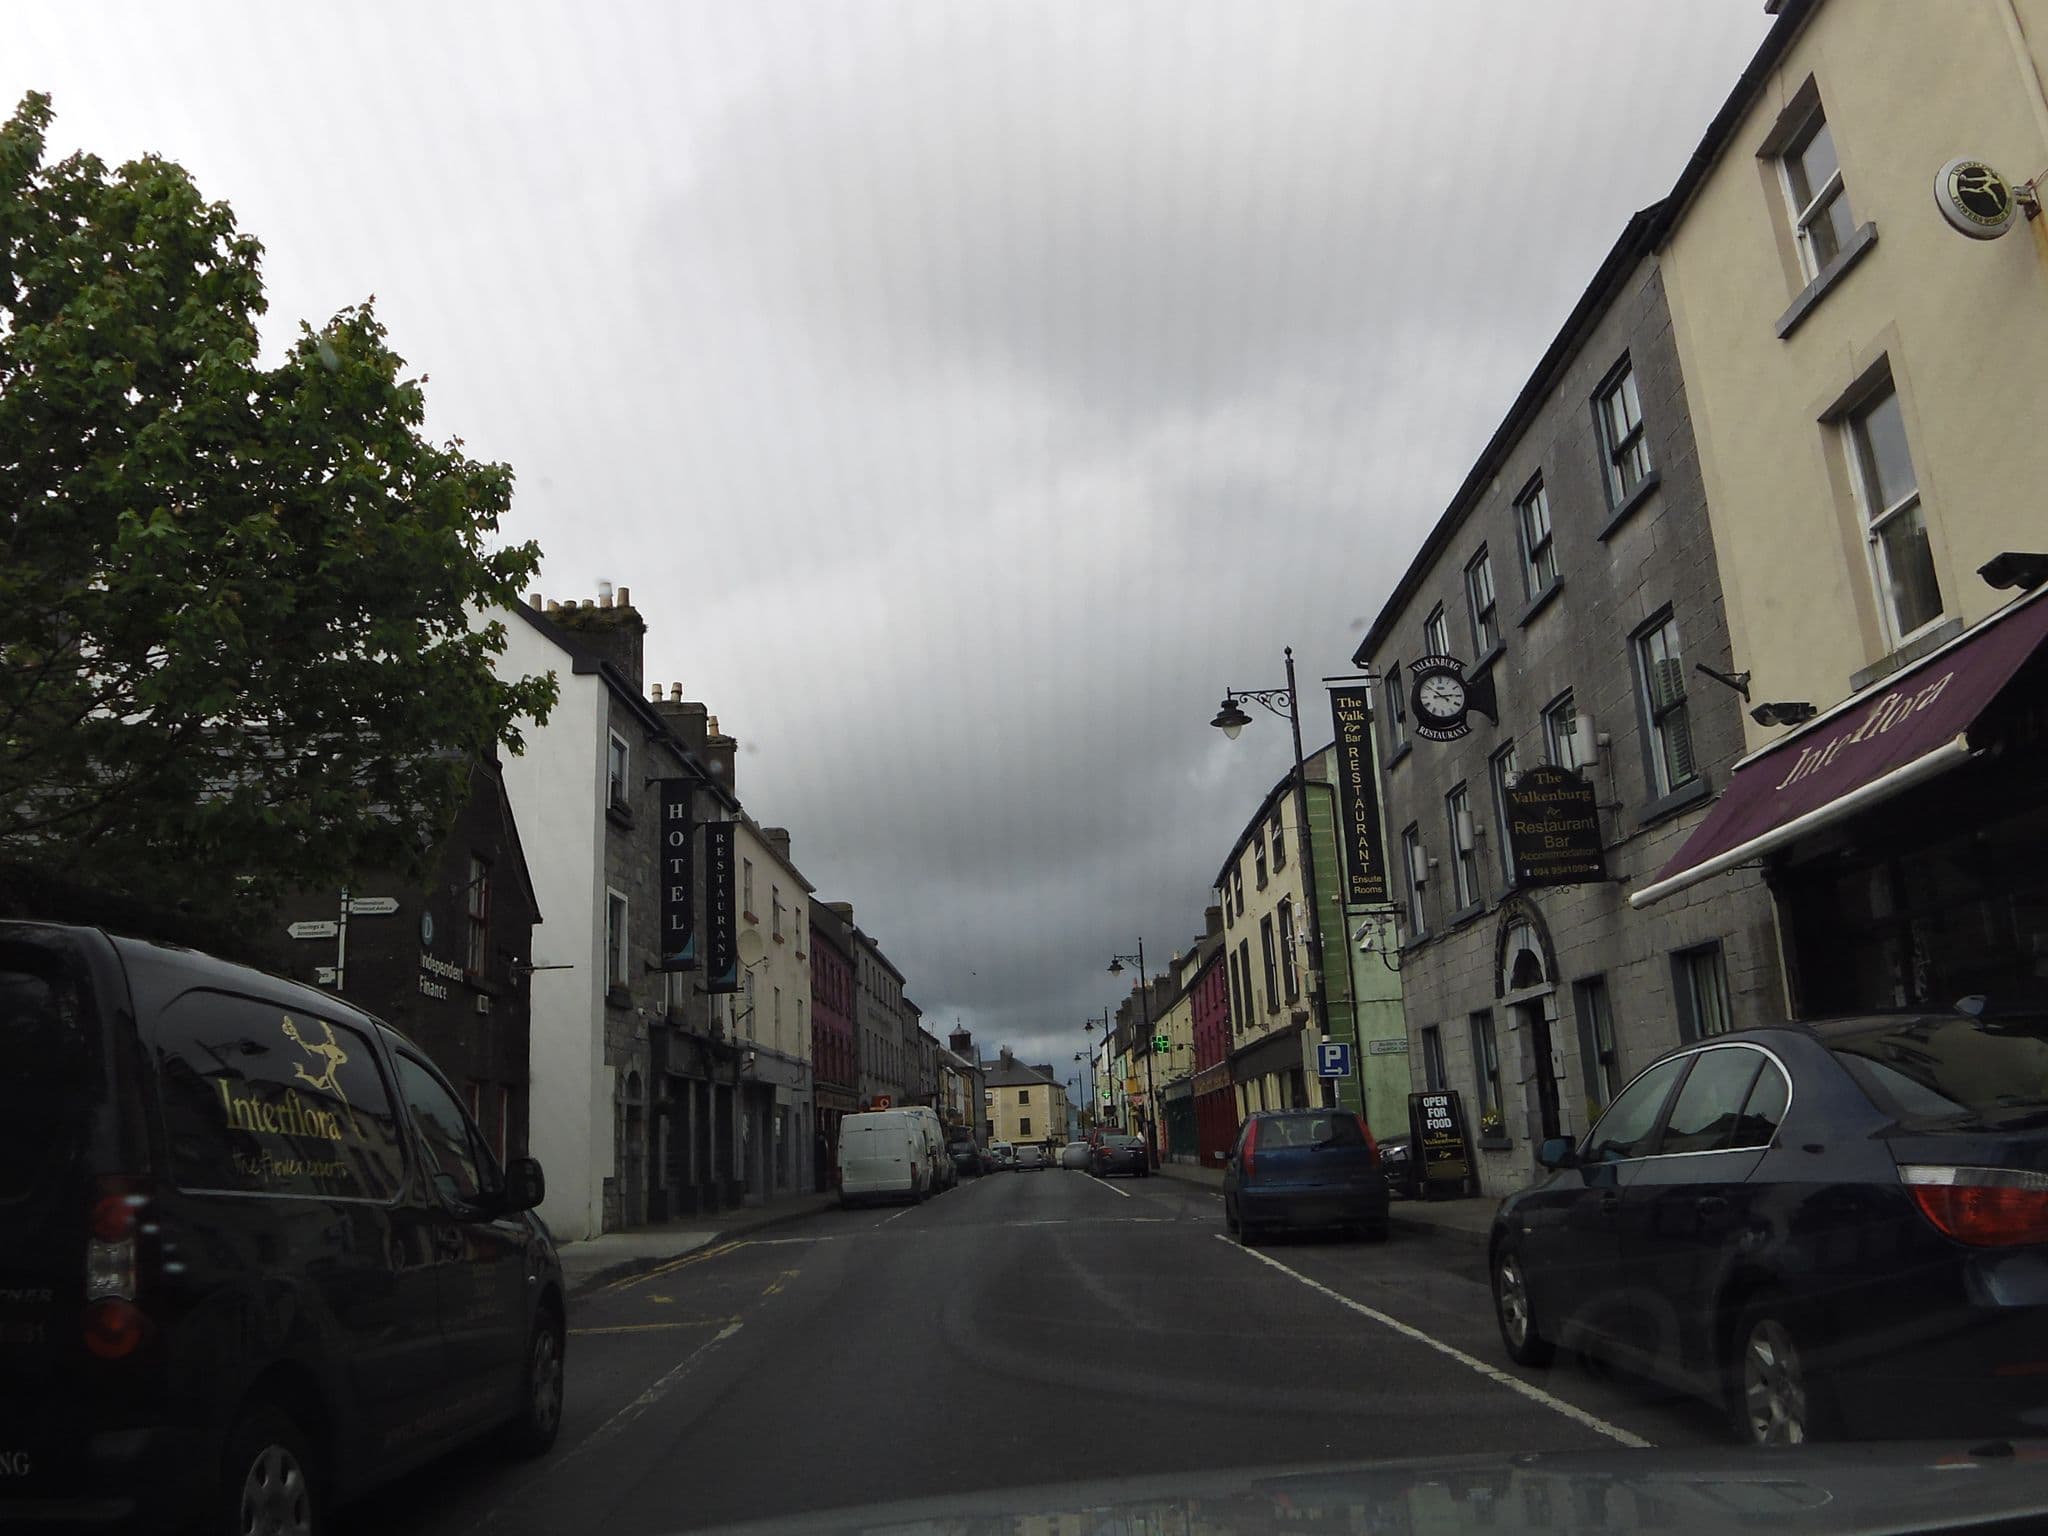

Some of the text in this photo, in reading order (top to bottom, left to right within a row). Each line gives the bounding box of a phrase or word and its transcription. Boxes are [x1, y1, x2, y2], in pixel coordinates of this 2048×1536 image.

[1411, 657, 1461, 672] VALKENBURG
[1336, 697, 1362, 708] The
[1337, 710, 1365, 721] Valk
[1345, 733, 1362, 743] Bar
[1418, 725, 1468, 740] RESTAURANT
[1534, 772, 1562, 785] The
[1511, 788, 1592, 804] Valkenburg
[1348, 747, 1370, 874] RESTAURANT
[1514, 817, 1595, 835] Restaurant
[1543, 835, 1570, 849] Bar
[668, 803, 685, 930] HOTEL
[1354, 886, 1383, 894] Rooms
[715, 833, 727, 967] RESTAURANT
[420, 949, 464, 983] Independent
[419, 974, 447, 1000] Finance
[1324, 1045, 1342, 1068] P
[217, 1077, 343, 1141] Interflora
[1422, 1096, 1448, 1107] OPEN
[1427, 1107, 1447, 1118] FOR
[1426, 1118, 1453, 1129] FOOD
